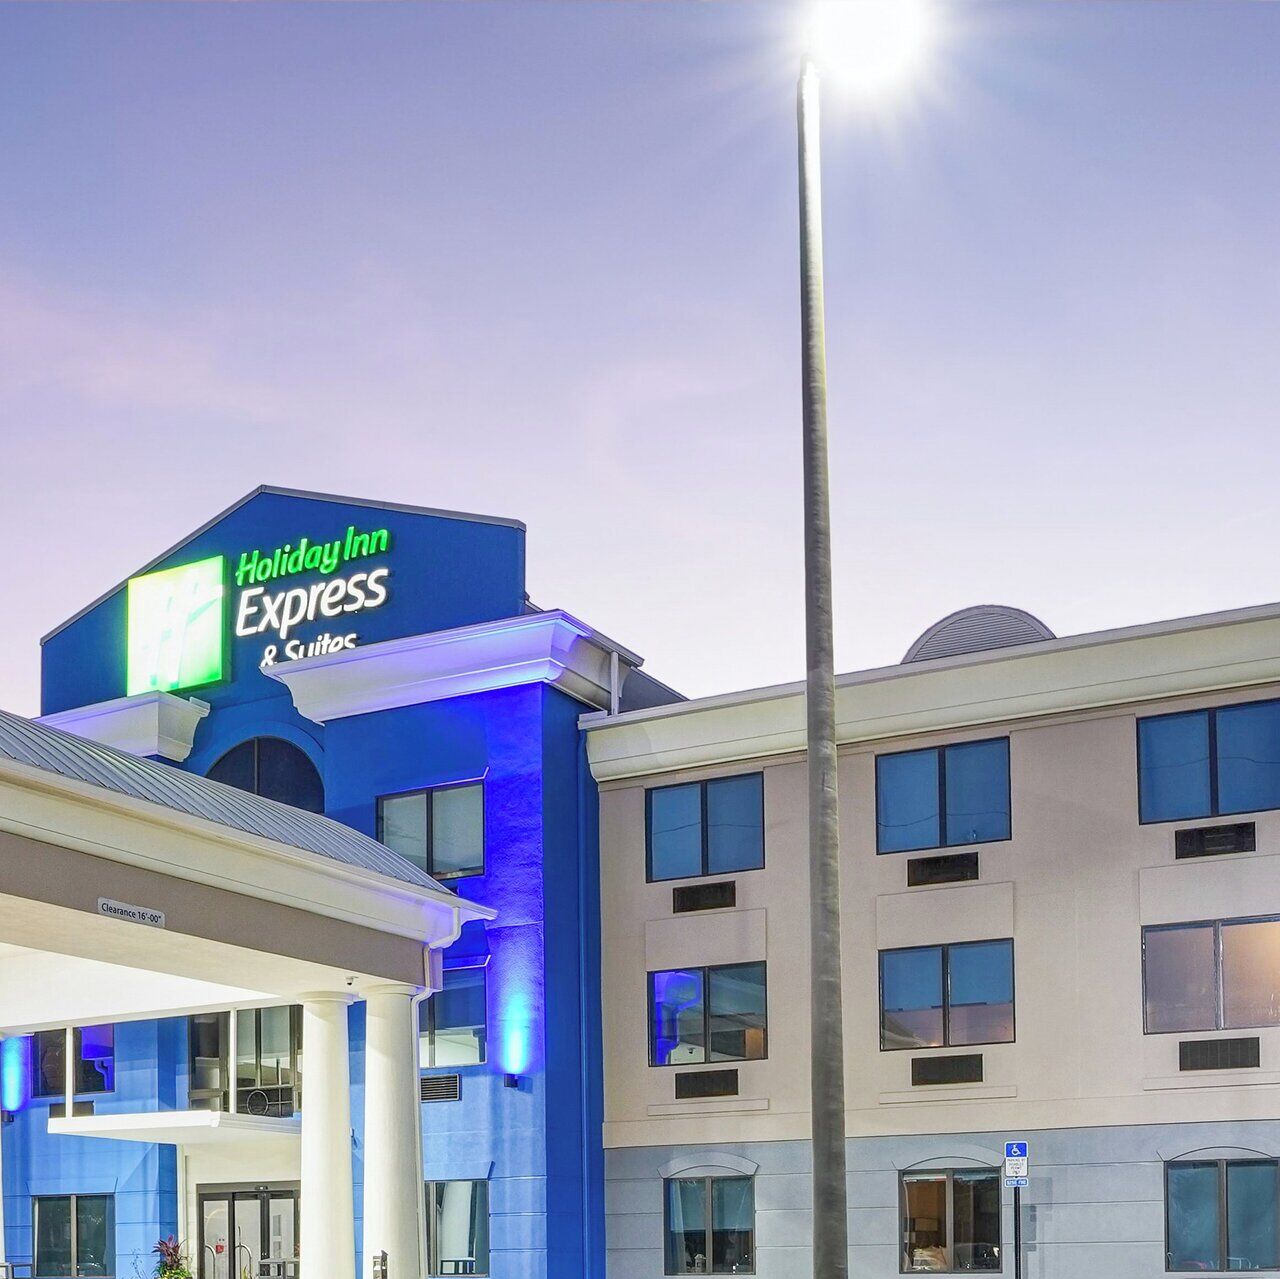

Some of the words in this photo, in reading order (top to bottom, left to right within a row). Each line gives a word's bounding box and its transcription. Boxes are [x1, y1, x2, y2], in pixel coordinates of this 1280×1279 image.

[236, 538, 341, 586] Holiday
[343, 526, 389, 561] Inn
[235, 568, 389, 639] Express
[260, 645, 277, 667] &
[101, 902, 136, 918] Clearance
